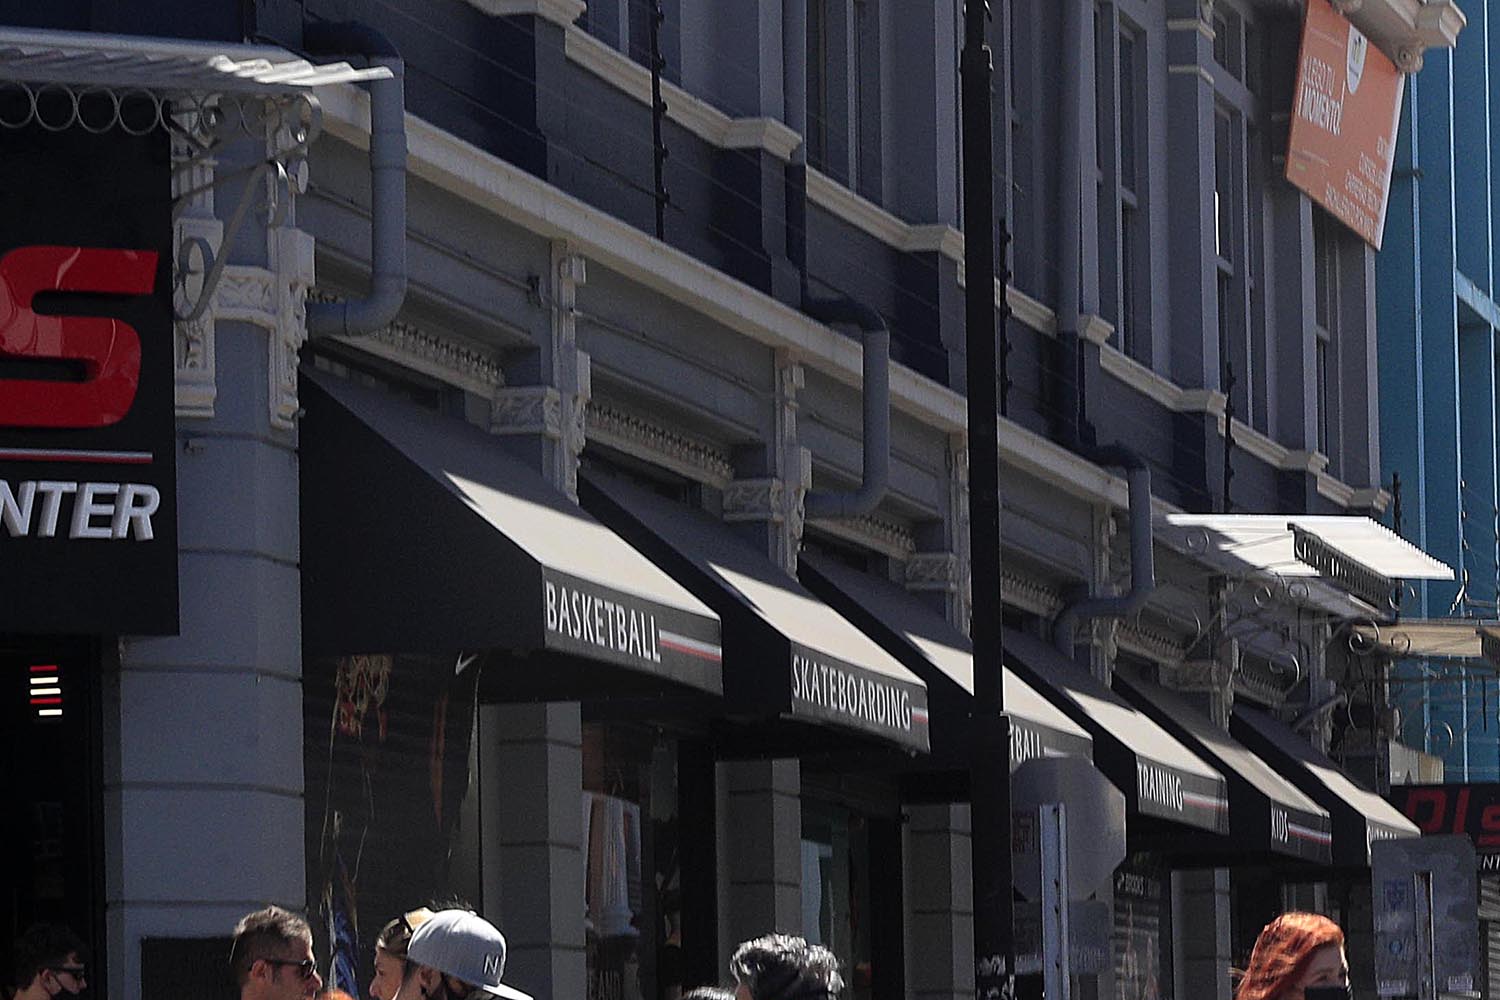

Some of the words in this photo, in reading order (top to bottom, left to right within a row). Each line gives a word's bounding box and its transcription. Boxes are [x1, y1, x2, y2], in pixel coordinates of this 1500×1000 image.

[546, 580, 661, 663] BASKETBALL
[793, 654, 911, 732] SKATEBOARDING
[1137, 764, 1184, 812] TRAINING
[1271, 807, 1289, 843] KIDS
